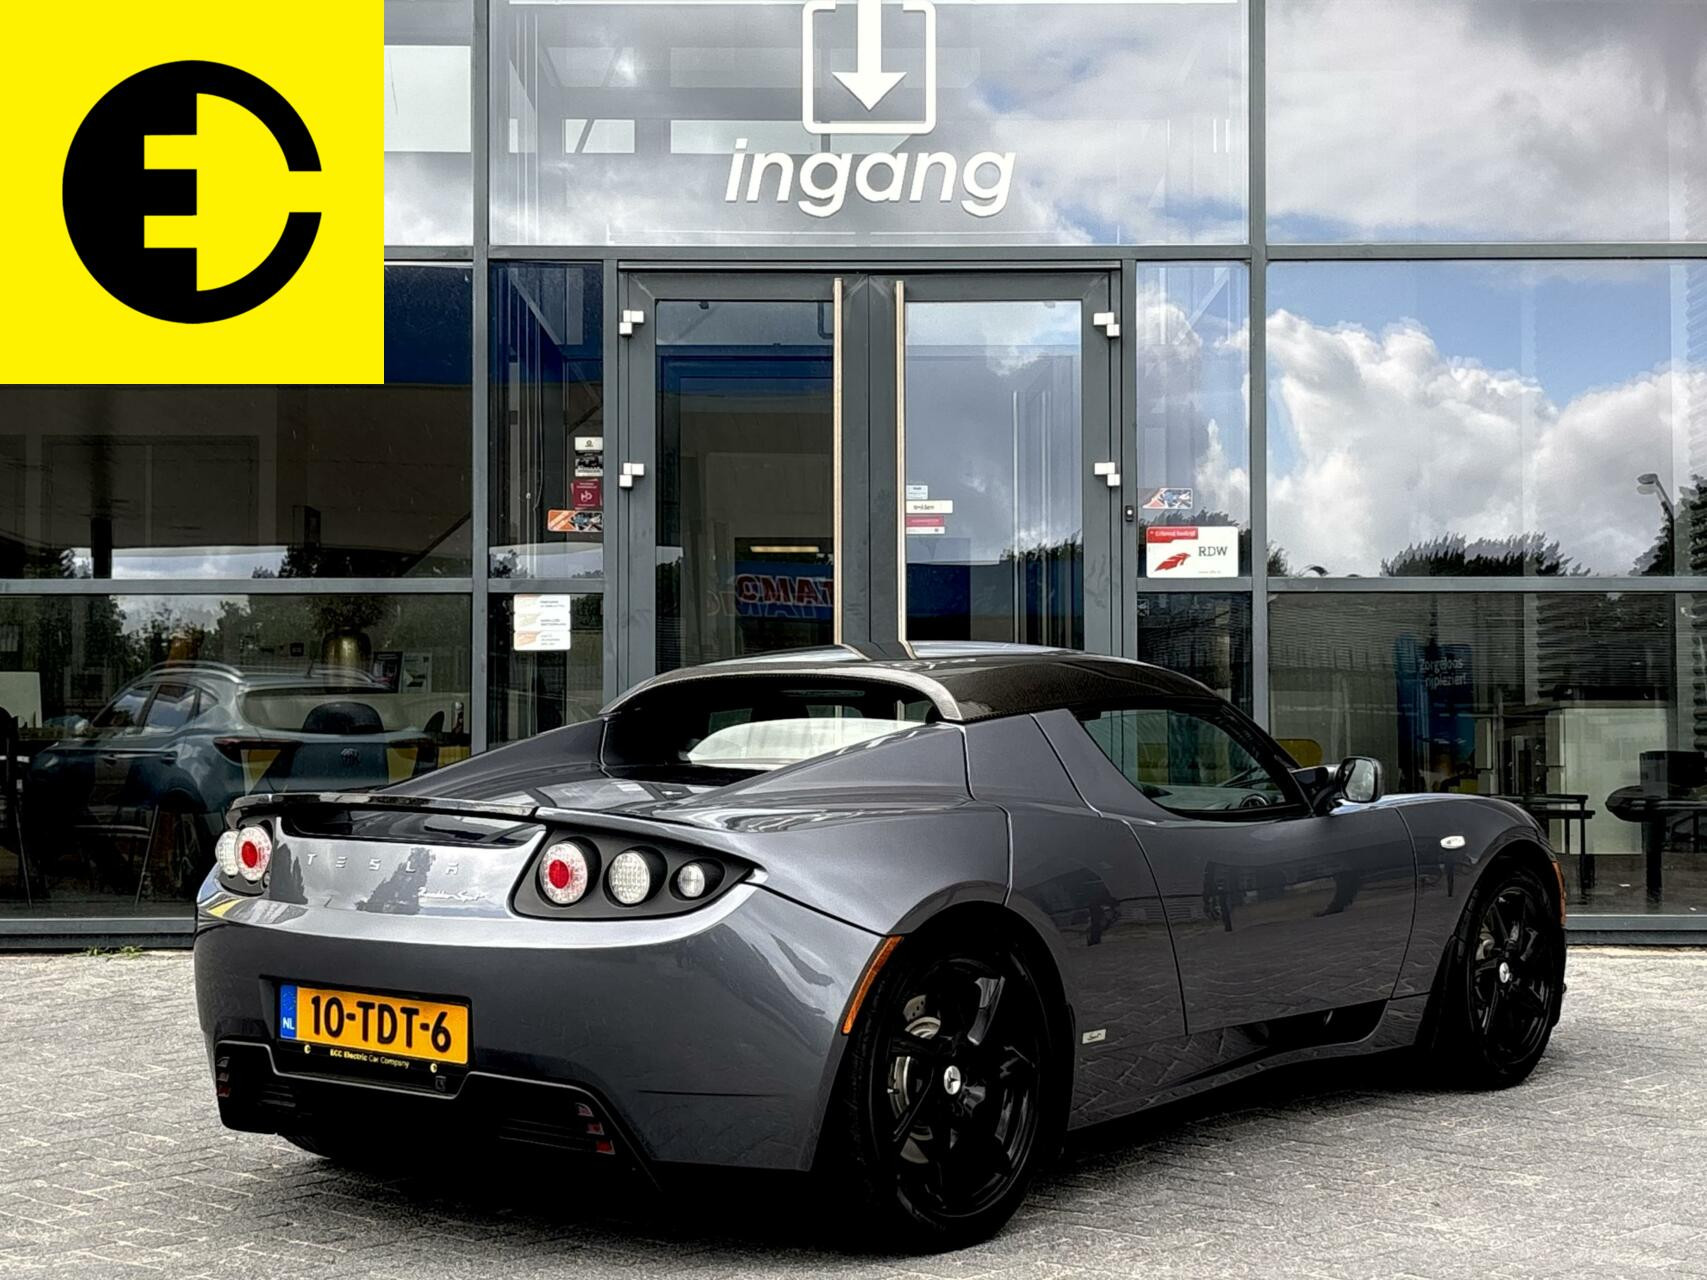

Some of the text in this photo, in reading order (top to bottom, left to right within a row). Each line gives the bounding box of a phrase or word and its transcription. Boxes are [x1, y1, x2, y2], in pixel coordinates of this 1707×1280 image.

[724, 138, 1016, 218] ingang
[1198, 546, 1228, 557] RDW
[306, 853, 459, 875] TESLA
[282, 1016, 295, 1030] NL
[310, 995, 452, 1053] 10-TDT-6
[344, 1051, 368, 1062] Electric
[368, 1054, 379, 1063] Car
[380, 1056, 410, 1069] Company
